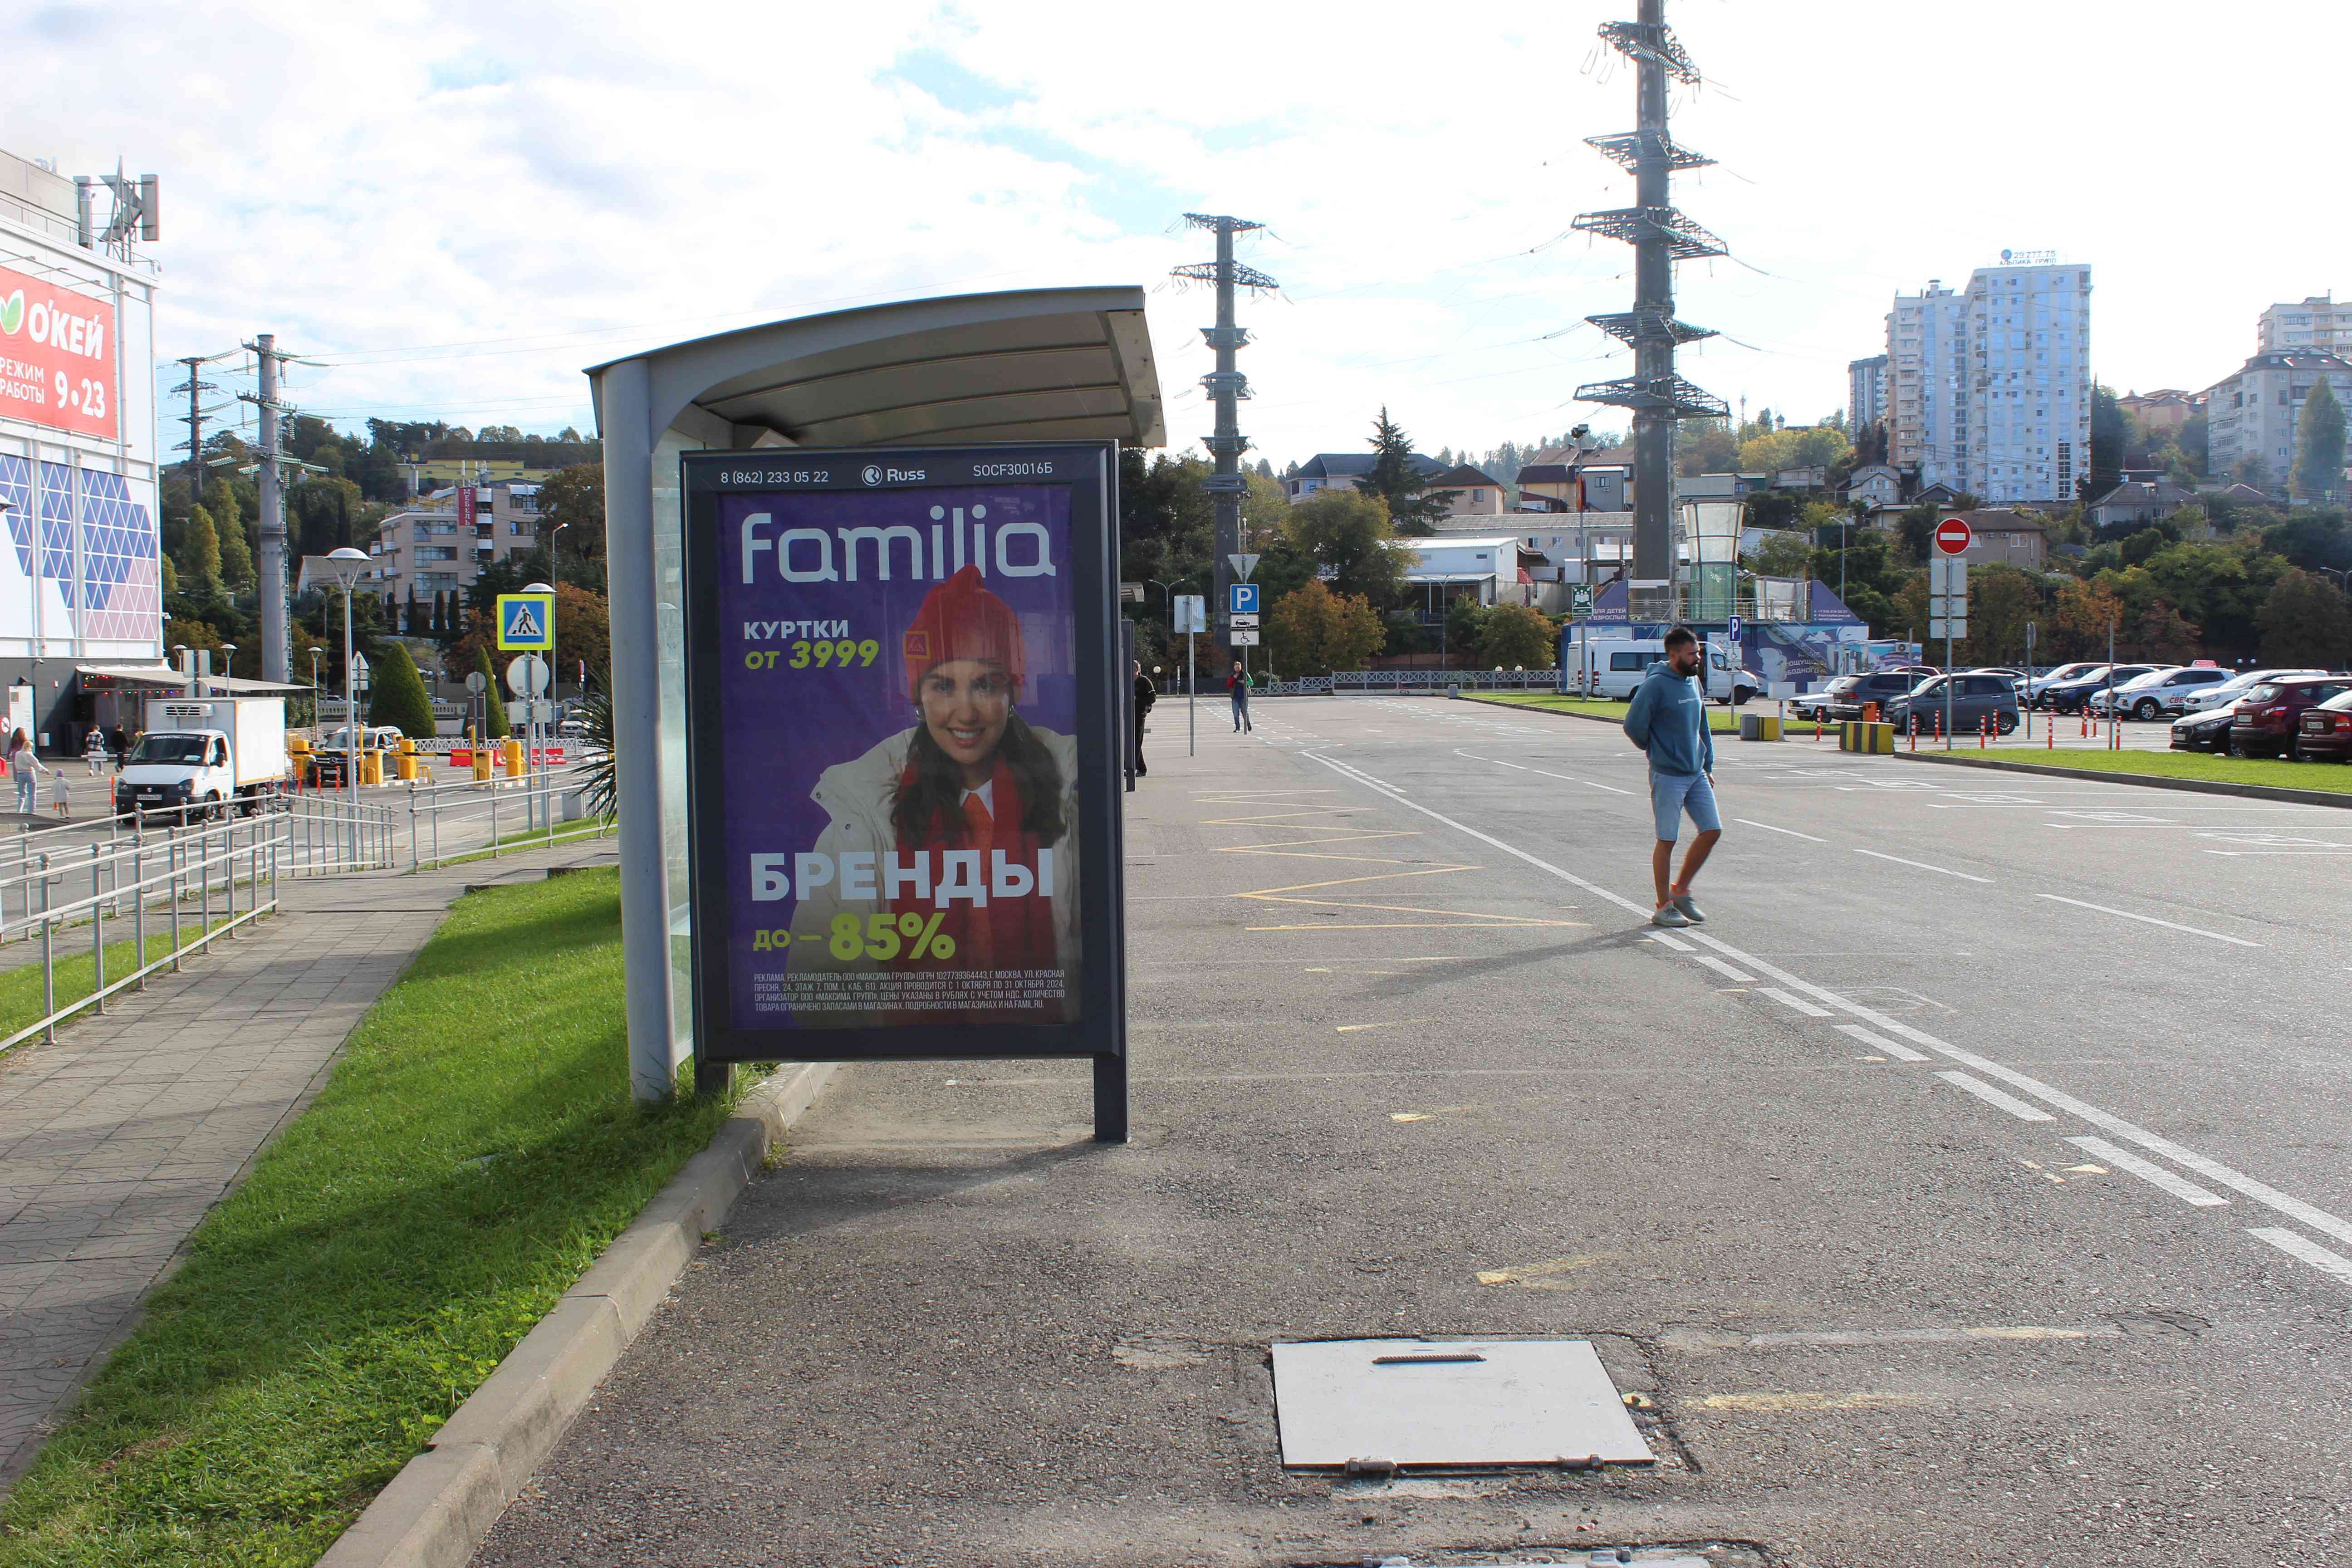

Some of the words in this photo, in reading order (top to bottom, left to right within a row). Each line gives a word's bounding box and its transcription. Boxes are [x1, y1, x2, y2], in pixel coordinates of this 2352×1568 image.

[0, 357, 44, 384] РЕЖИМ
[0, 378, 44, 404] РАБОТЫ
[721, 472, 728, 483] 8
[733, 470, 763, 484] (862)
[767, 472, 790, 483] 233
[794, 472, 809, 483] 05
[813, 471, 828, 482] 22
[887, 469, 926, 482] Russ
[742, 505, 1056, 584] familia
[1237, 588, 1252, 609] P
[744, 620, 849, 640] КУРТКИ
[1731, 618, 1739, 639] P
[789, 639, 879, 668] 3999
[750, 848, 1054, 908] БРЕНДЫ
[754, 974, 785, 982] РЕКЛАМА.
[787, 973, 842, 981] РЕКЛАМОДАТЕЛЬ
[843, 972, 855, 980] ООО
[916, 971, 935, 980] (ОГРН
[1035, 970, 1064, 978] КРАСНАЯ
[880, 982, 902, 990] АКЦИЯ
[904, 981, 946, 990] ПРОВОДИТСЯ
[962, 981, 990, 989] ОКТЯБРЯ
[994, 980, 1002, 989] ПО
[1015, 980, 1044, 988] ОКТЯБРЯ
[755, 993, 798, 1001] ОРГАНИЗАТОР
[801, 993, 813, 1001] ООО
[881, 992, 899, 1000] ЦЕНЫ
[942, 991, 968, 999] РУБЛЯХ
[970, 990, 975, 999] С
[1024, 990, 1065, 998] КОЛИЧЕСТВО
[755, 1003, 780, 1011] ТОВАРА
[781, 1003, 820, 1011] ОГРАНИЧЕНО
[822, 1002, 857, 1010] ЗАПАСАМИ
[858, 1002, 862, 1010] В
[906, 1001, 951, 1009] ПОДРОБНОСТИ
[958, 1000, 997, 1009] МАГАЗИНАХ
[1004, 1000, 1013, 1008] НА
